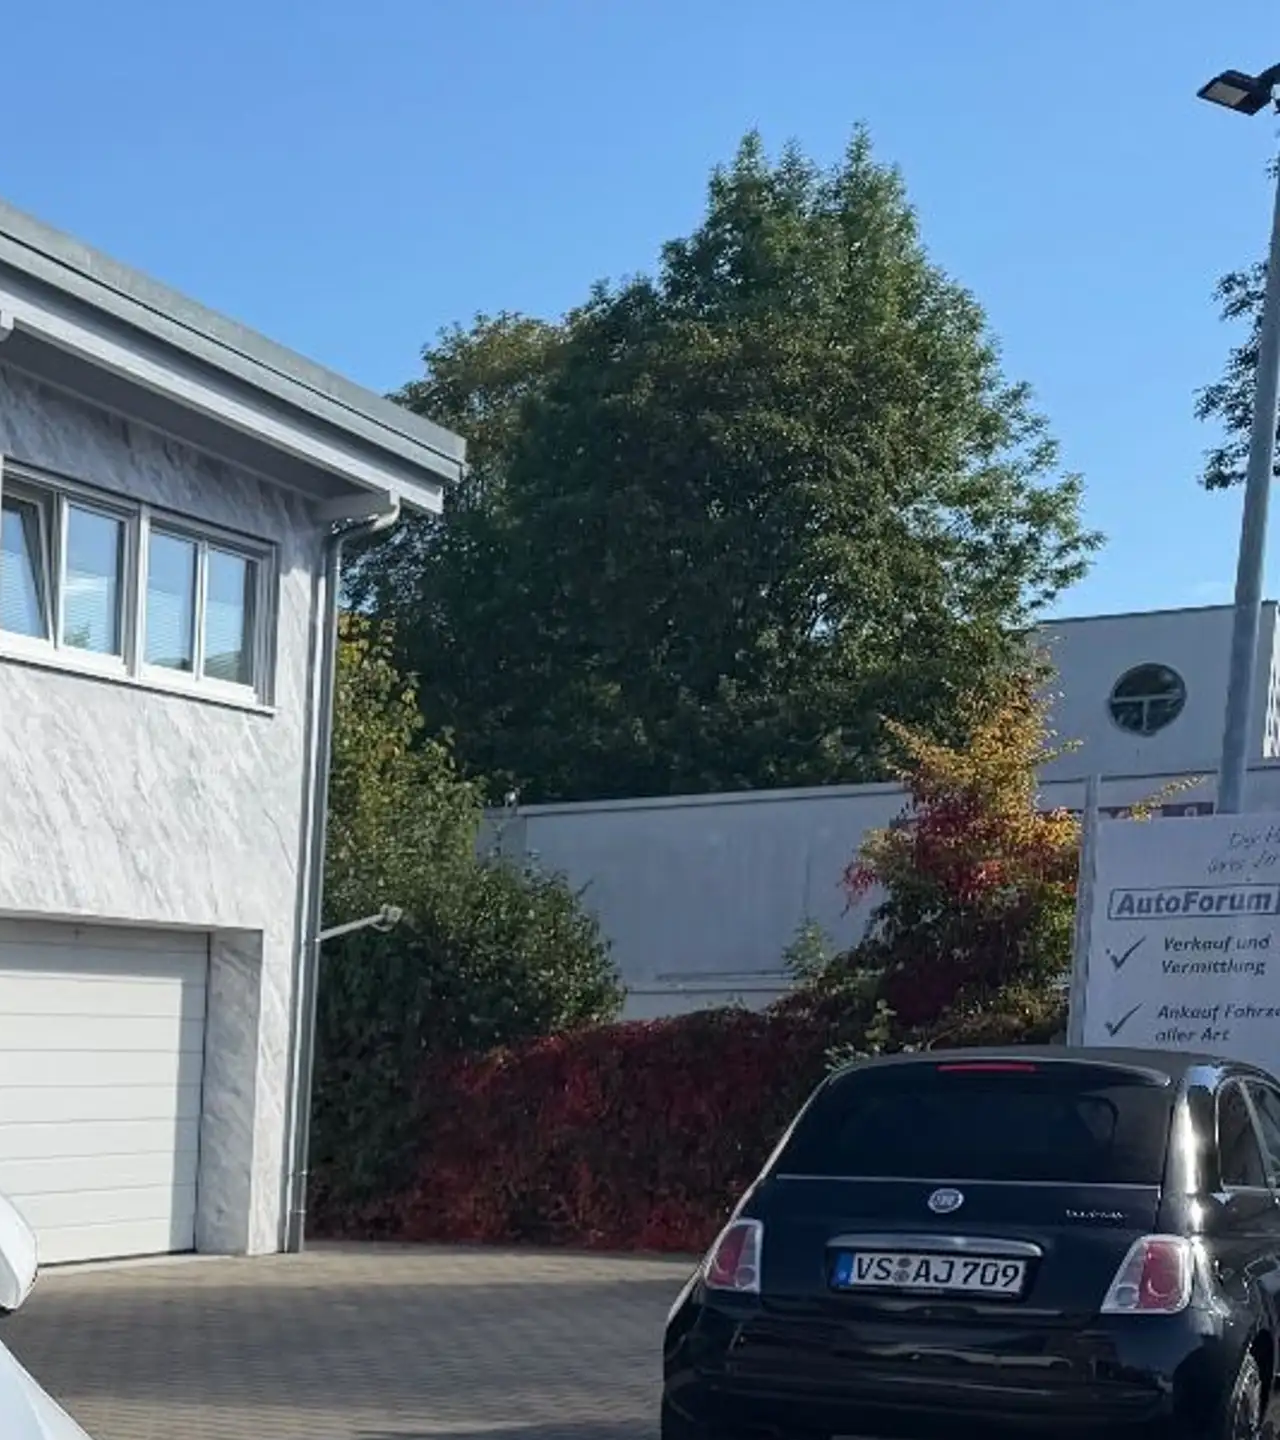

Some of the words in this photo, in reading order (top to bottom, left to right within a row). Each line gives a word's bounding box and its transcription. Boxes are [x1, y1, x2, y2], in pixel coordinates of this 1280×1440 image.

[1116, 891, 1272, 916] AutoForum
[1163, 935, 1232, 954] Verkauf
[1236, 932, 1272, 951] und
[1161, 957, 1266, 977] Vermittlung
[1157, 1004, 1220, 1022] Ankauf
[1154, 1027, 1196, 1043] aller
[855, 1257, 894, 1281] VS
